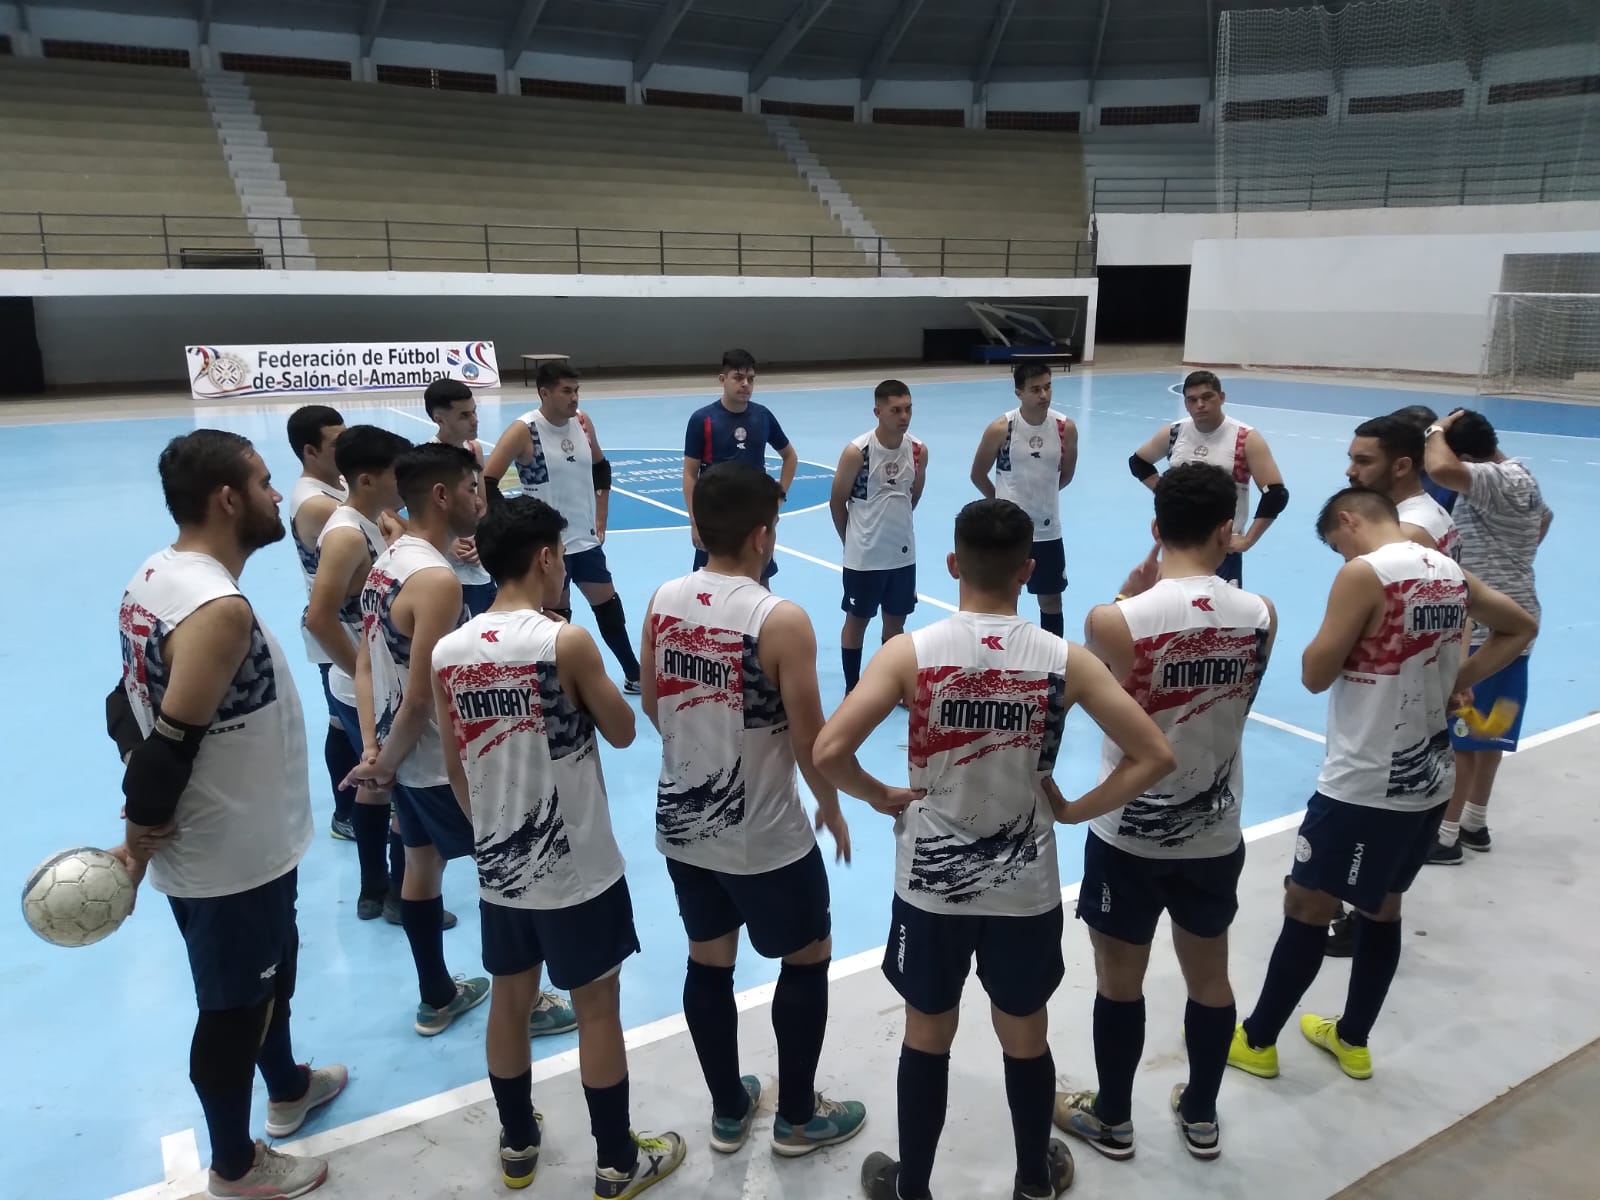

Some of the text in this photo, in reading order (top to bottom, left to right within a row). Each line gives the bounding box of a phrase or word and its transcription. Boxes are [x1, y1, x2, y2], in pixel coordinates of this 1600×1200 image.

[258, 347, 440, 368] Federación de Fútbol
[252, 371, 275, 389] de
[281, 370, 331, 388] Salón
[337, 369, 363, 387] del
[664, 648, 731, 689] AMAMBAY
[1163, 658, 1249, 688] AMAMBAY
[941, 699, 1037, 731] AMAMBAY
[1347, 842, 1365, 886] KYRIOS
